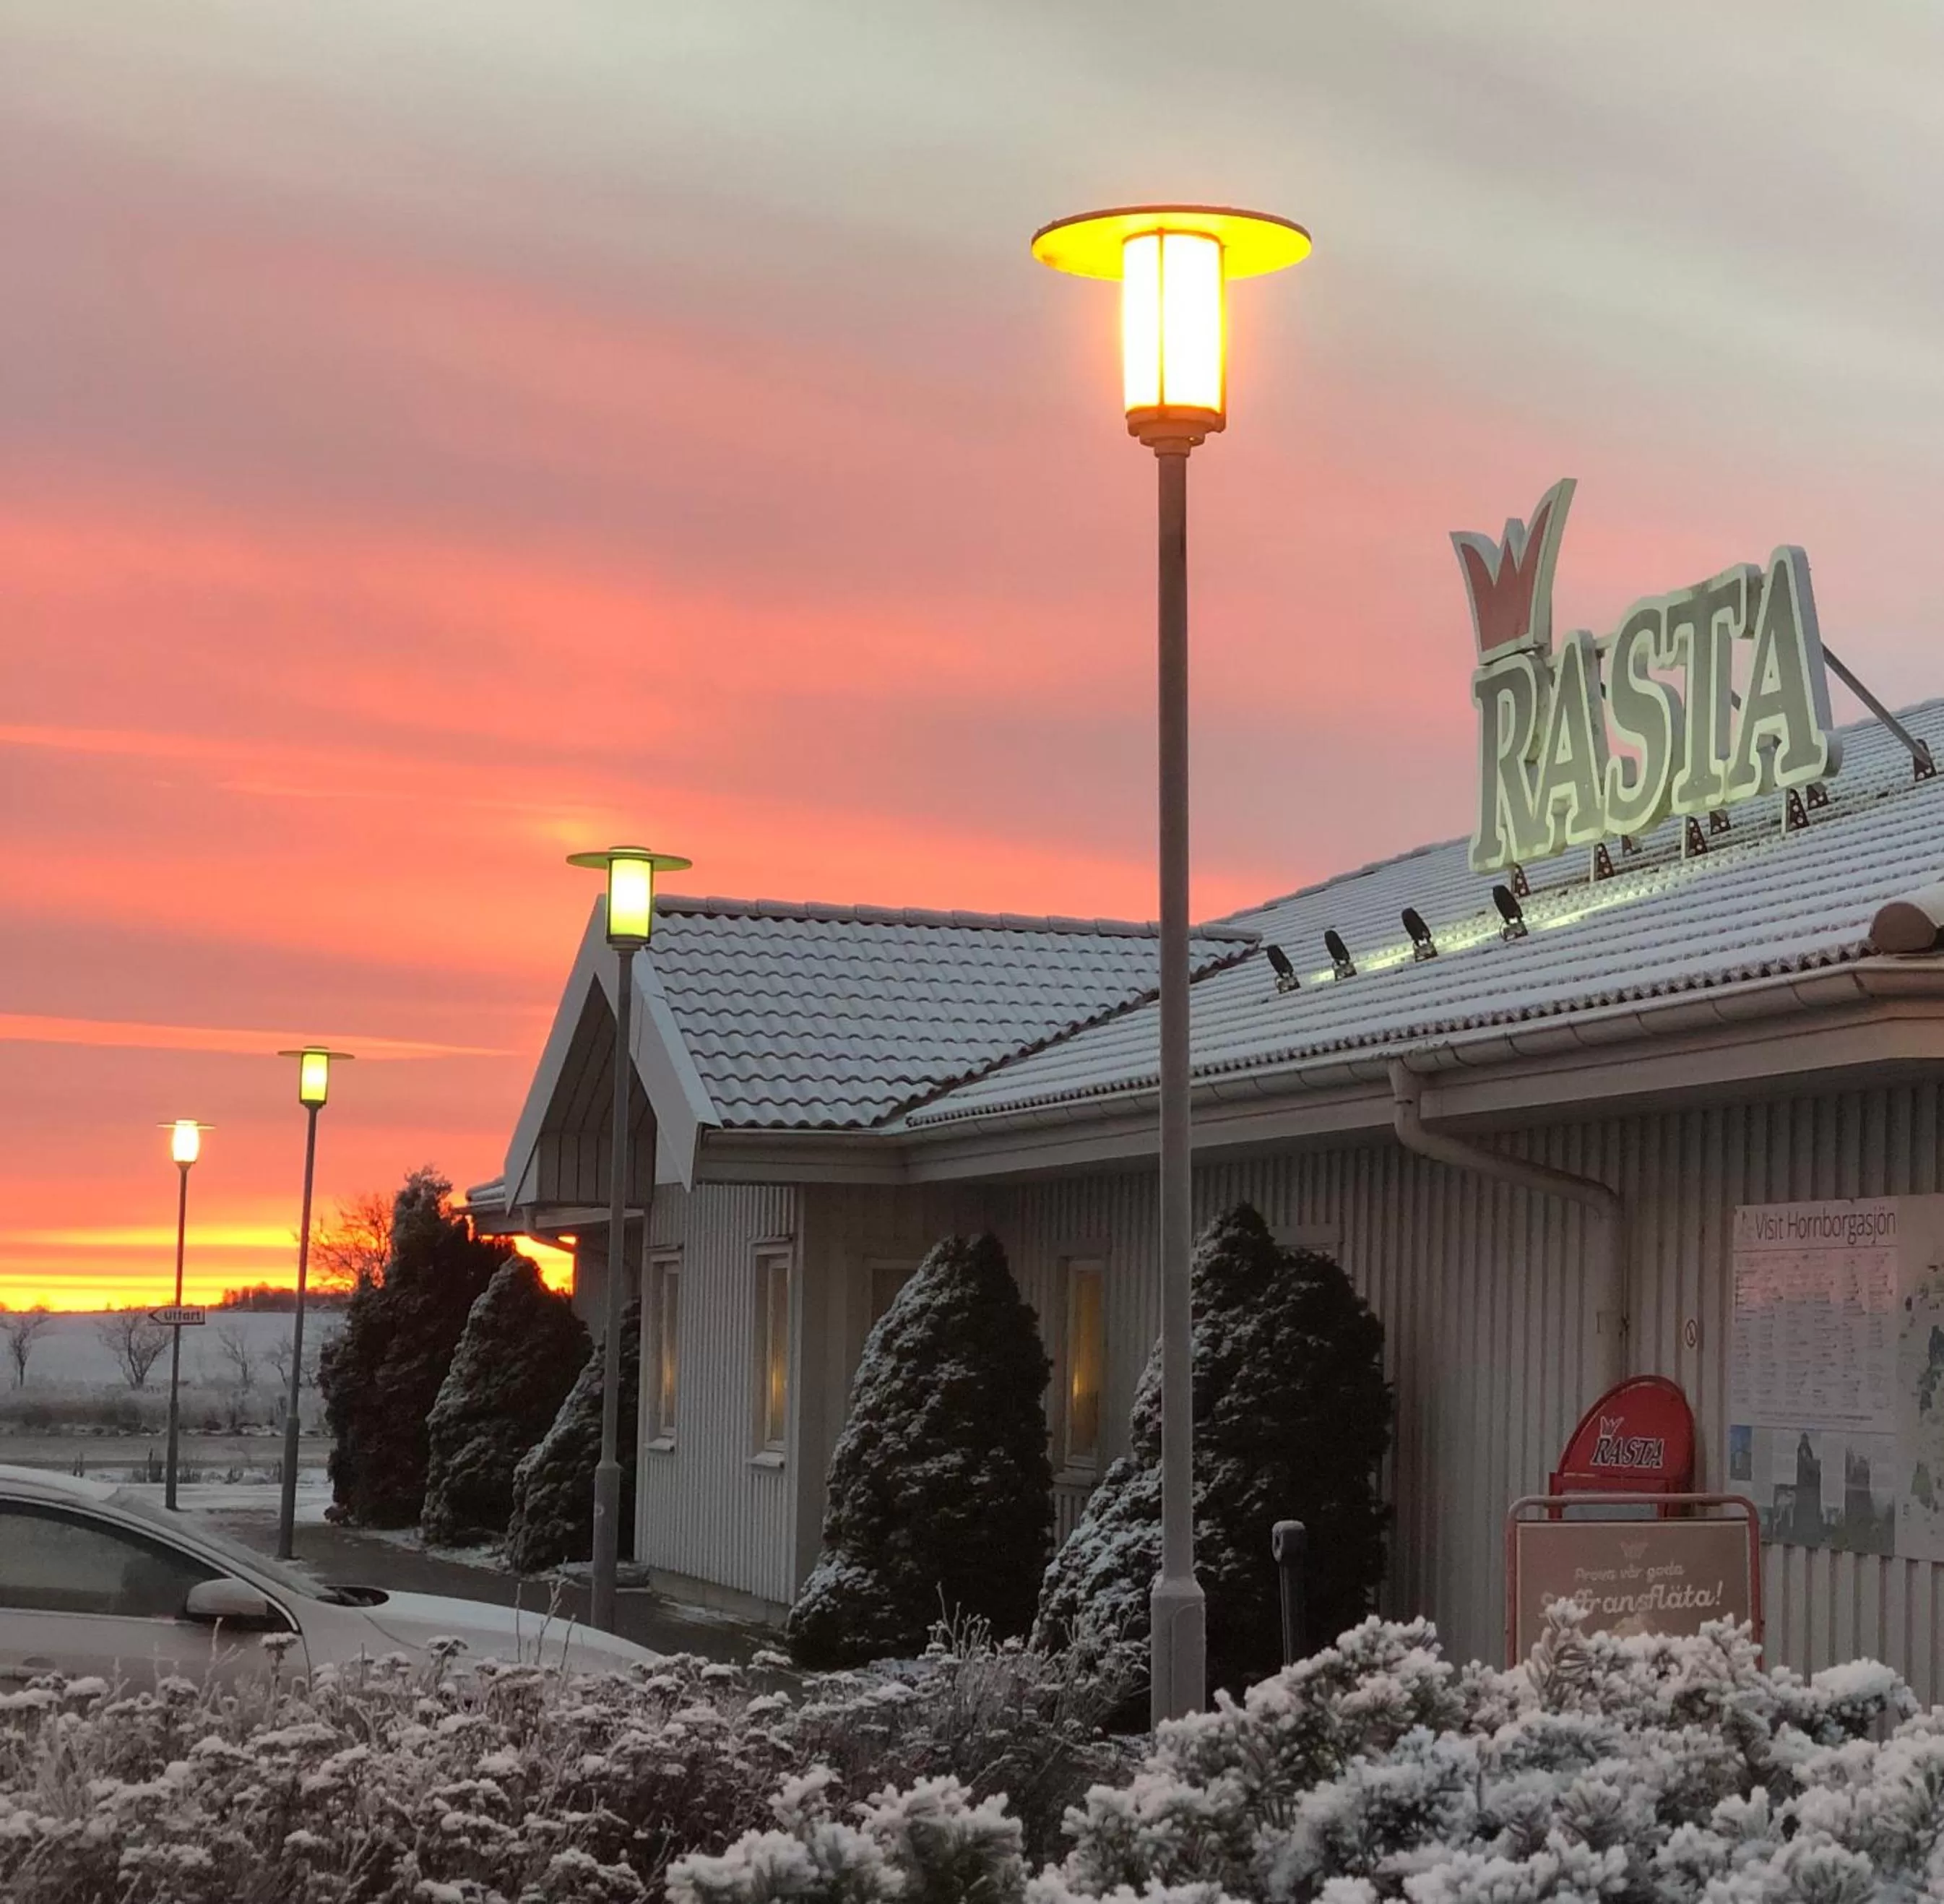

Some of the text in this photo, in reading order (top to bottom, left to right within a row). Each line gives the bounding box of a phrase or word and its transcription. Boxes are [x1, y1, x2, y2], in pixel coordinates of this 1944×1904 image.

[1469, 545, 1842, 871] RASTA
[1755, 1206, 1896, 1245] Visit Hornborgasjön
[1590, 1436, 1665, 1469] RASTA
[1620, 1563, 1643, 1579] vår
[1646, 1560, 1685, 1583] goda
